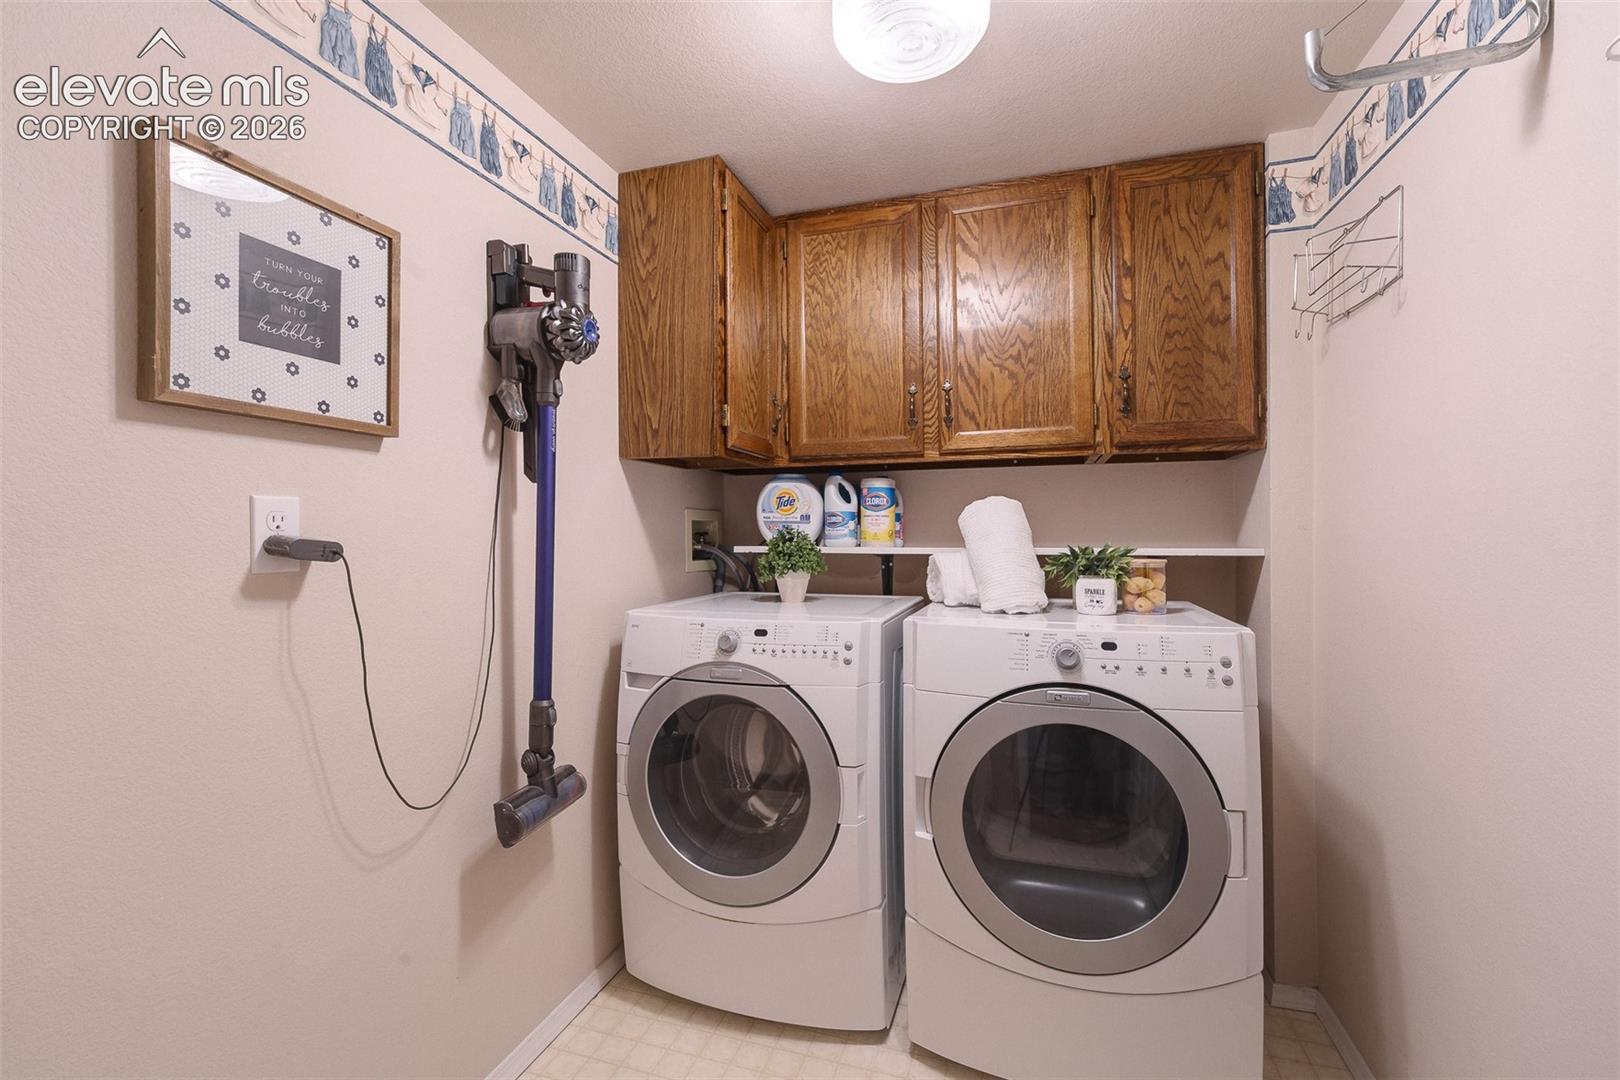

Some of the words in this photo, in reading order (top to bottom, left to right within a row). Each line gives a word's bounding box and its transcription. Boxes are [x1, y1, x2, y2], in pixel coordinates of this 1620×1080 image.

[264, 257, 292, 273] TURN
[296, 269, 324, 285] YOUR
[251, 270, 331, 312] troubles
[280, 304, 306, 318] INTO
[257, 314, 325, 349] bubbles
[776, 495, 796, 510] Tide
[866, 497, 888, 505] CLOROX
